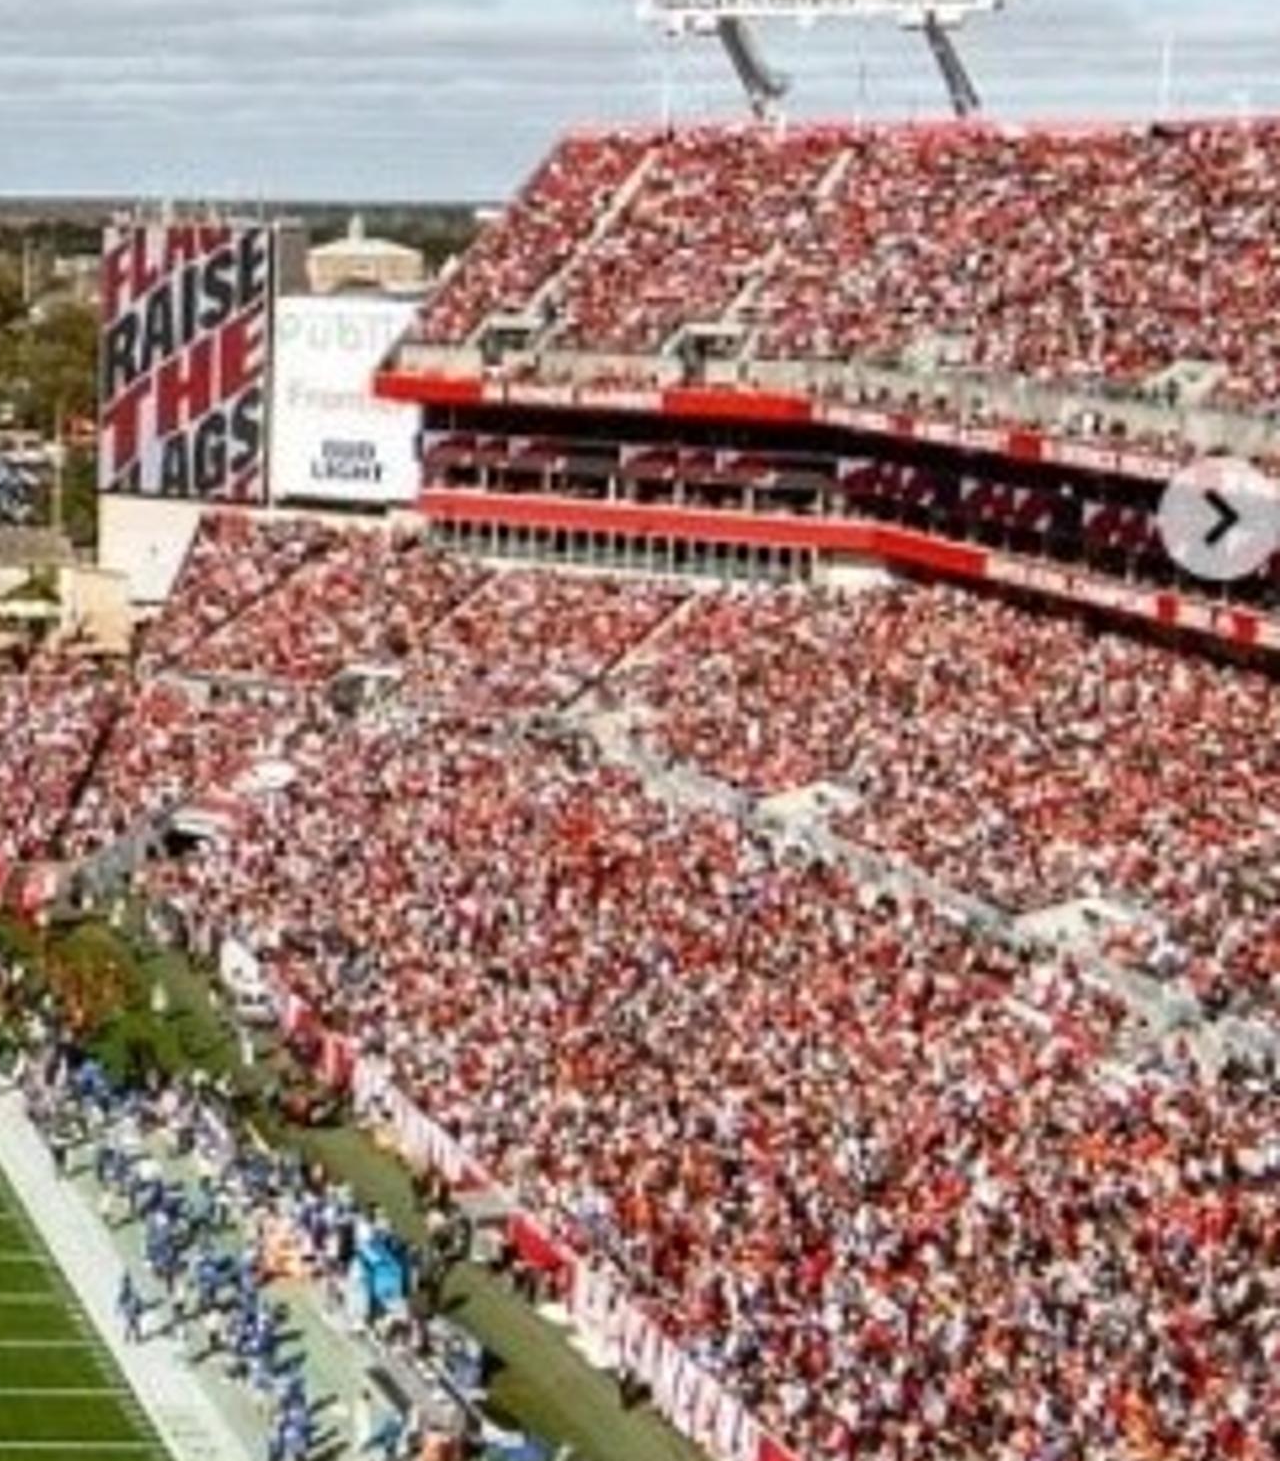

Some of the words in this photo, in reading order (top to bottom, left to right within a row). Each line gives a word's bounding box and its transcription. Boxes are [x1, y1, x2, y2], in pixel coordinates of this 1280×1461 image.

[103, 300, 264, 469] THE
[106, 227, 266, 407] RAISE
[321, 439, 376, 460] BUD
